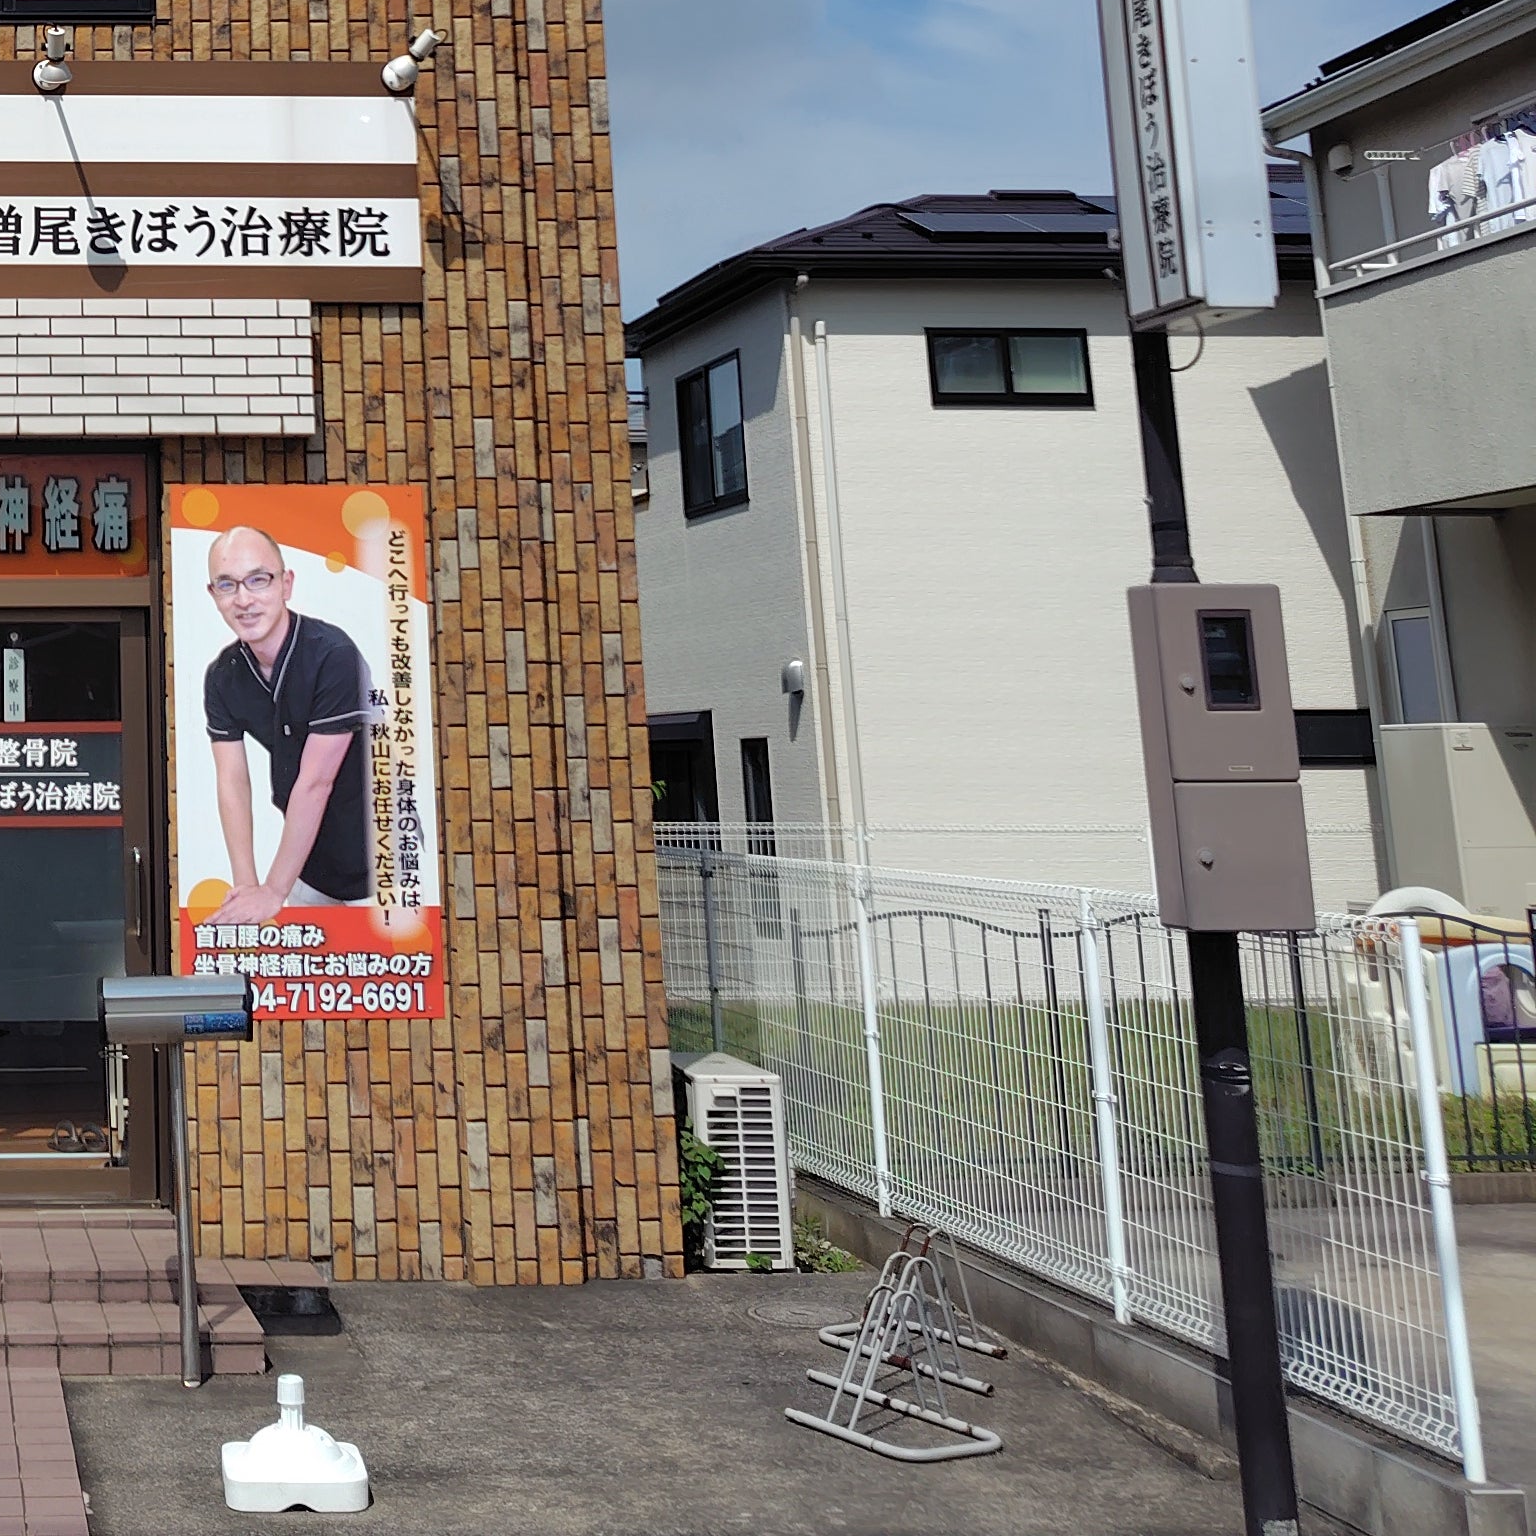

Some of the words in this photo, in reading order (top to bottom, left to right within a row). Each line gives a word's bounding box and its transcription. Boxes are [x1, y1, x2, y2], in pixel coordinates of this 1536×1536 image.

[194, 924, 326, 949] 首肩腰の痛み
[194, 952, 433, 977] 坐骨神経痛にお悩みの方
